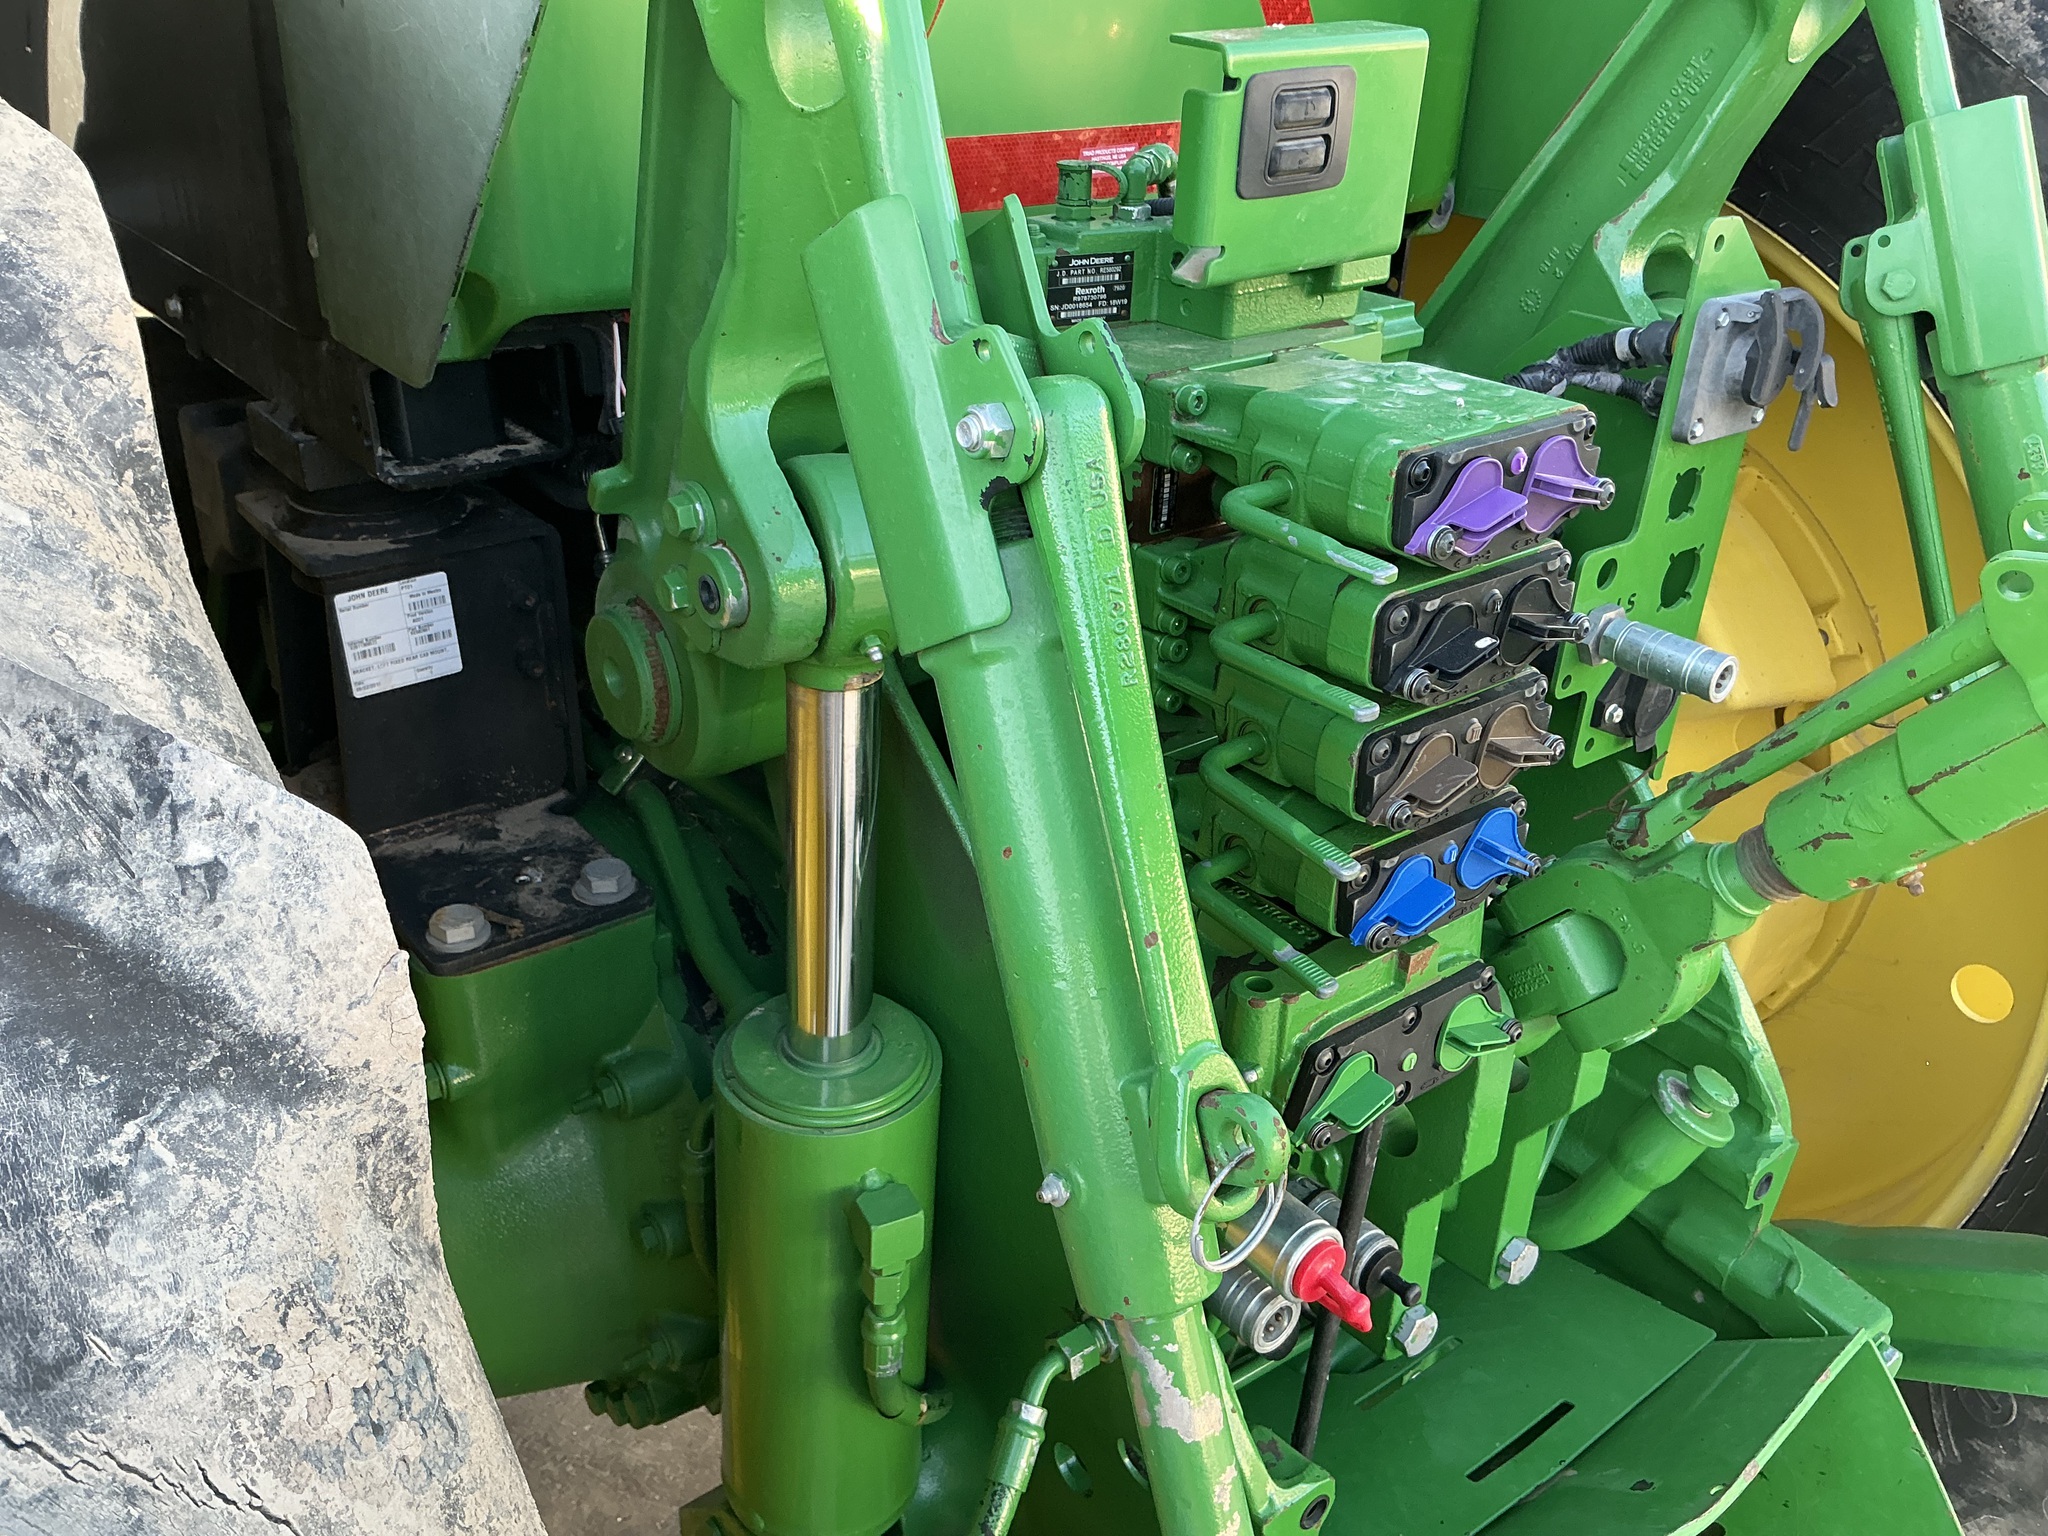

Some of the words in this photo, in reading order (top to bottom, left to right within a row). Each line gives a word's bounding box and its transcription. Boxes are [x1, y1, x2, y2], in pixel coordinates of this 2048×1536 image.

[1069, 258, 1090, 267] JOHN
[1090, 256, 1114, 265] DEERE
[1075, 286, 1106, 296] Rexroth
[1085, 457, 1109, 512] USA
[348, 592, 366, 602] JOHN
[367, 587, 389, 598] DEERE
